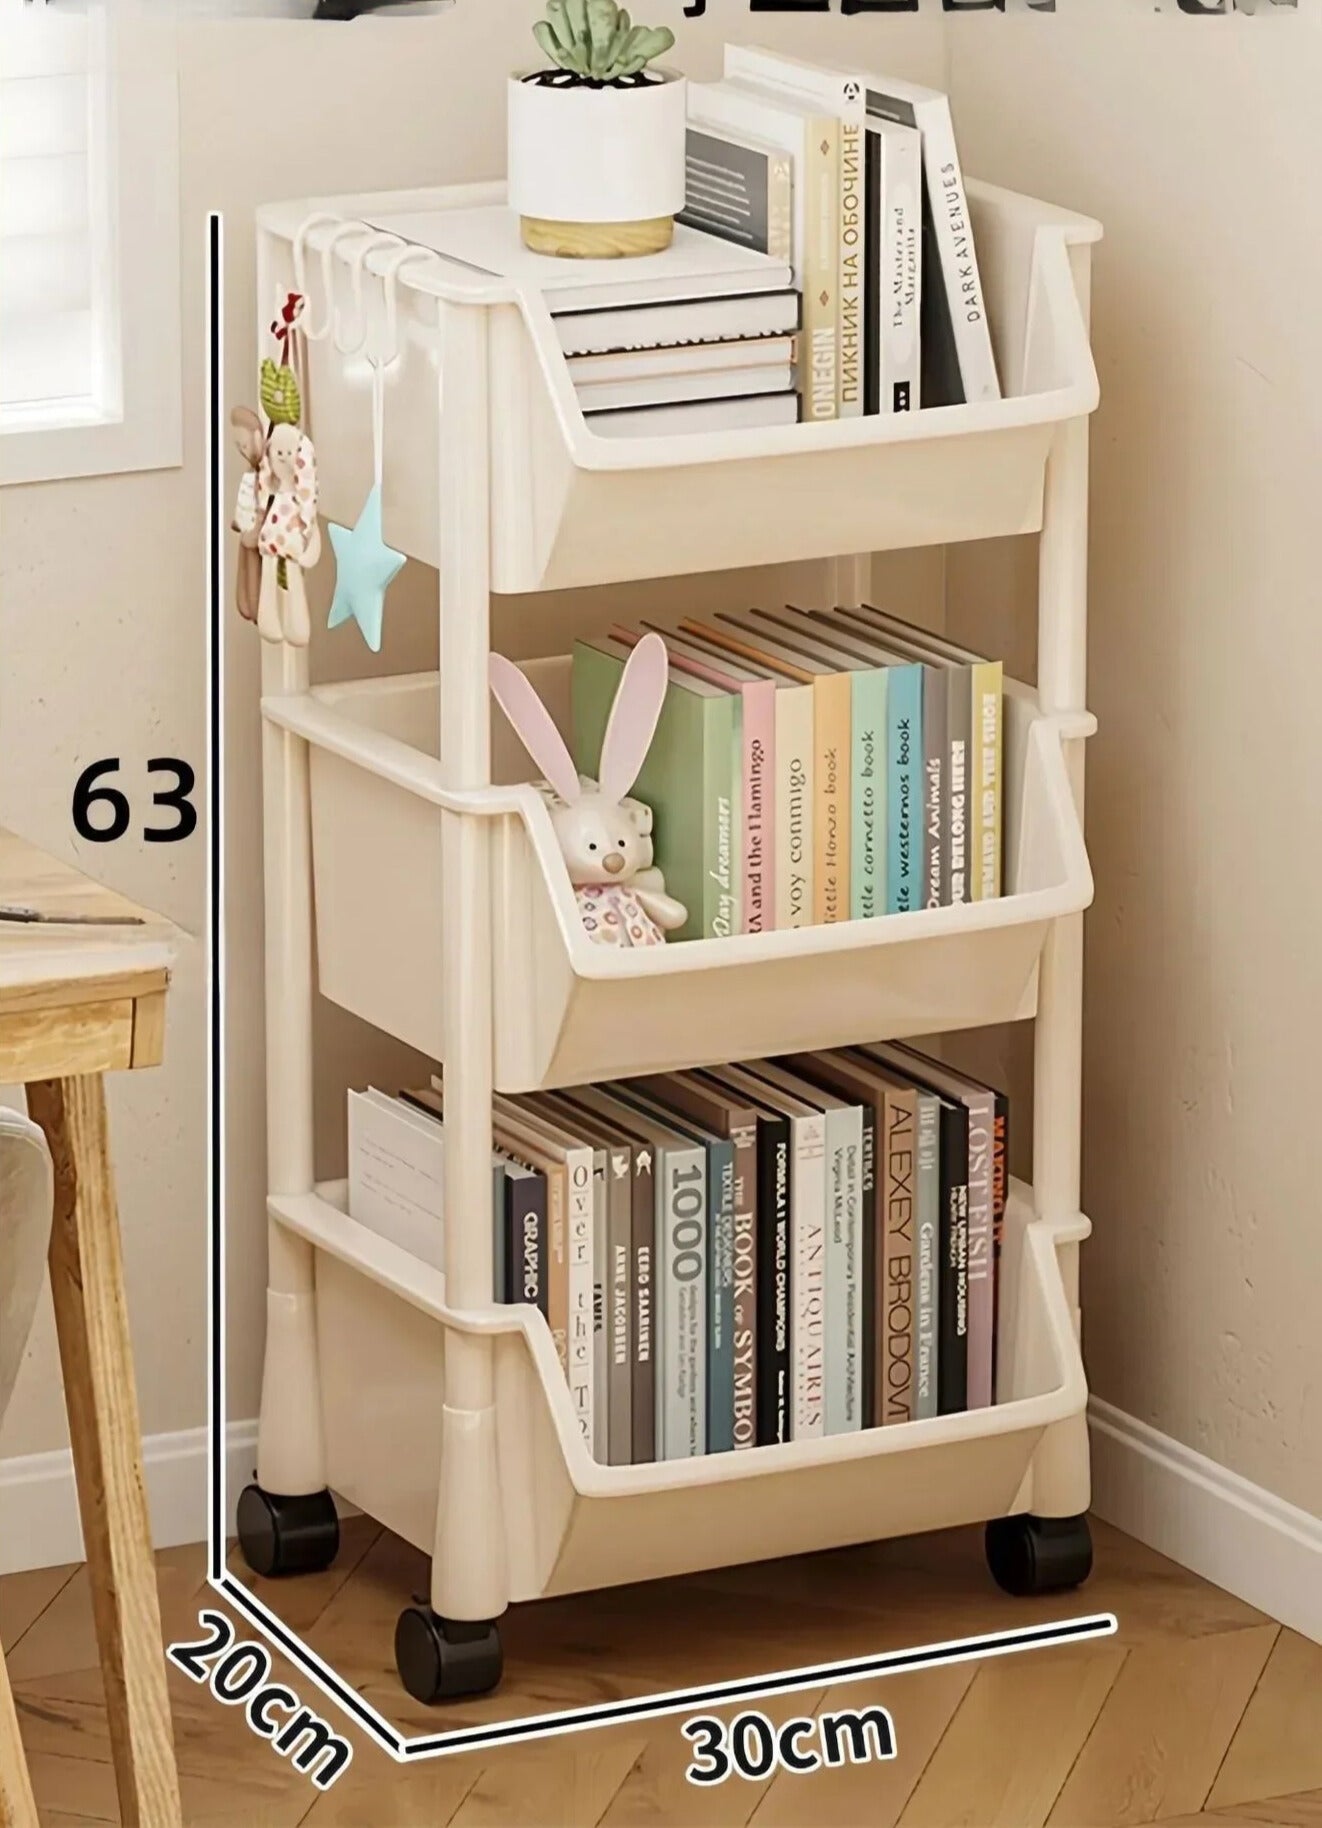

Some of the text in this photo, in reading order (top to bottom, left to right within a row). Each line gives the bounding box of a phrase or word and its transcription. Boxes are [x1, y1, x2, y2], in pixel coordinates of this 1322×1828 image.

[842, 123, 859, 402] ПИКНИК НА ОБОЧИНЕ
[940, 161, 981, 323] DARK AVENUES
[811, 327, 835, 417] ONEGIN
[860, 730, 875, 778] book
[897, 718, 911, 766] book
[748, 835, 762, 867] the
[788, 758, 807, 863] conmigo
[927, 757, 941, 909] Dream Animals
[709, 797, 738, 937] Day dreamers
[748, 873, 762, 910] and
[789, 873, 805, 916] voy
[672, 1164, 703, 1283] 1000
[889, 1104, 913, 1242] ALEXEY
[967, 1105, 989, 1280] LOST FISH
[523, 1211, 539, 1299] GRAPHIC
[733, 1212, 753, 1299] BOOK
[918, 1222, 934, 1399] Gardens in France
[802, 1224, 823, 1428] ANTIQUAIRES
